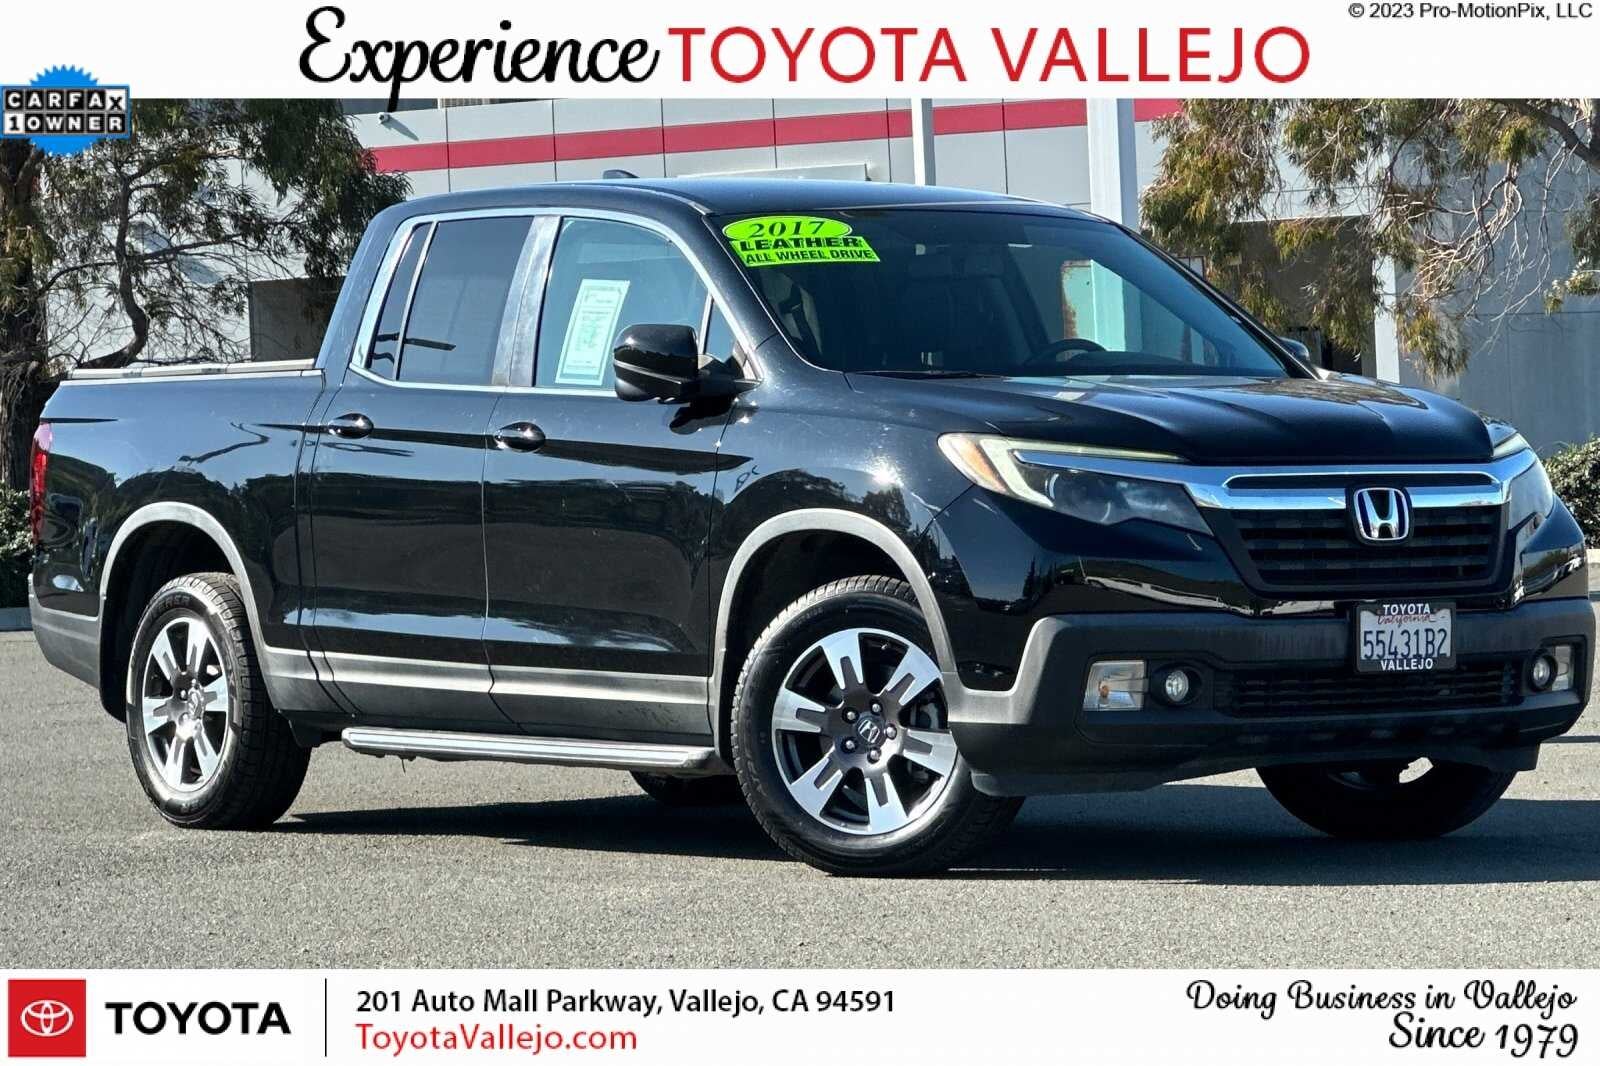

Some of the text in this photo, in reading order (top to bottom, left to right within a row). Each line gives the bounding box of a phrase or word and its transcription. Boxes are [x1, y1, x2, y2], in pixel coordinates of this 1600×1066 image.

[749, 220, 825, 238] 2017
[739, 237, 860, 252] LEATHER
[746, 249, 873, 264] ALL WHEEL DRIVE
[1382, 603, 1431, 615] TOYOTA
[1363, 628, 1448, 659] 55431B2
[1380, 658, 1434, 671] VALLEJO
